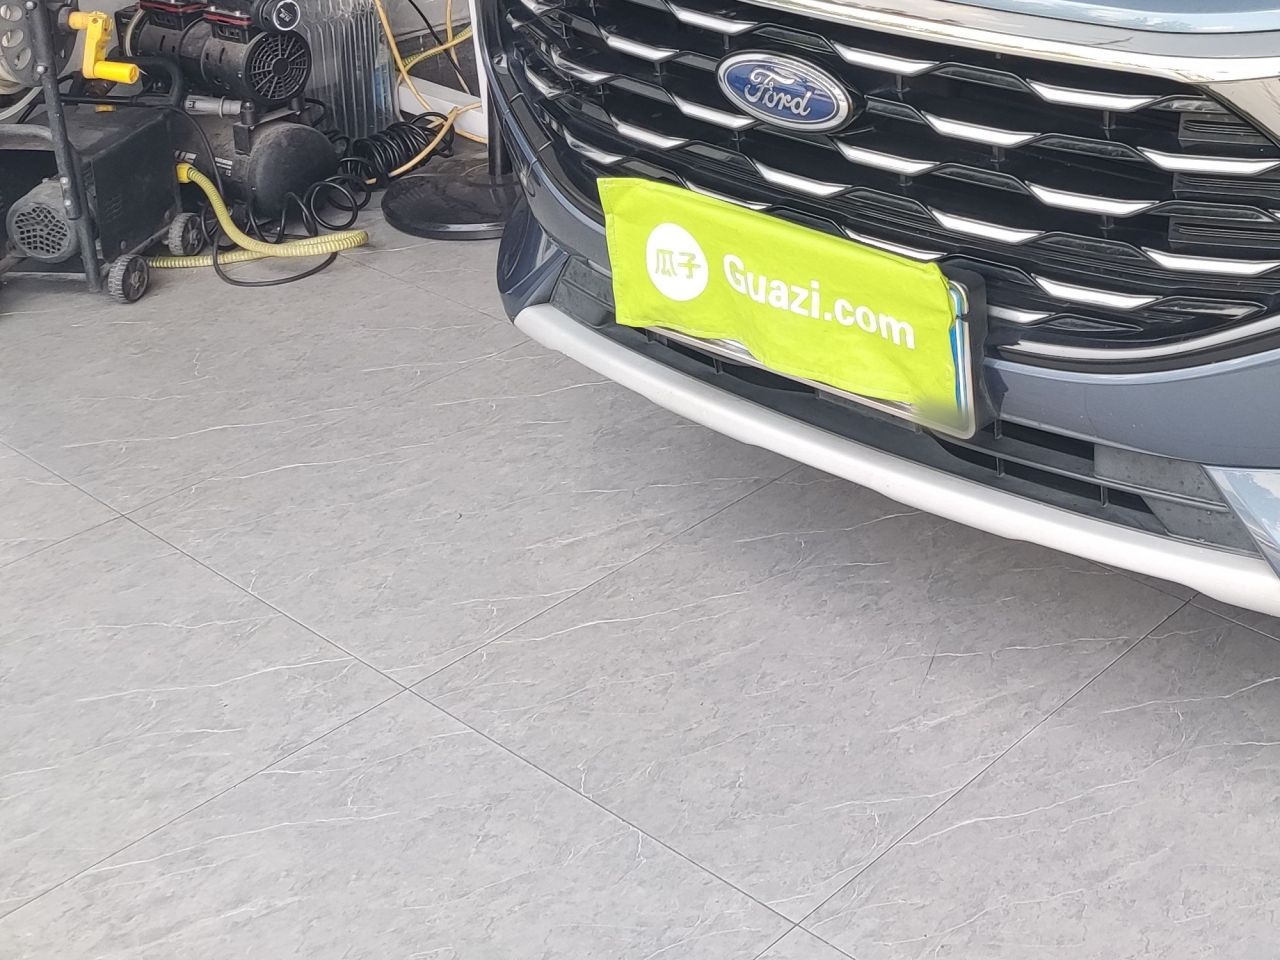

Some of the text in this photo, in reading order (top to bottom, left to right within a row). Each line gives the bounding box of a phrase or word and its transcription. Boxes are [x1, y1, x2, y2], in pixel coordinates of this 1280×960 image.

[744, 69, 811, 117] Ford
[655, 248, 702, 280] 瓜子
[722, 254, 916, 350] Guazi.com
